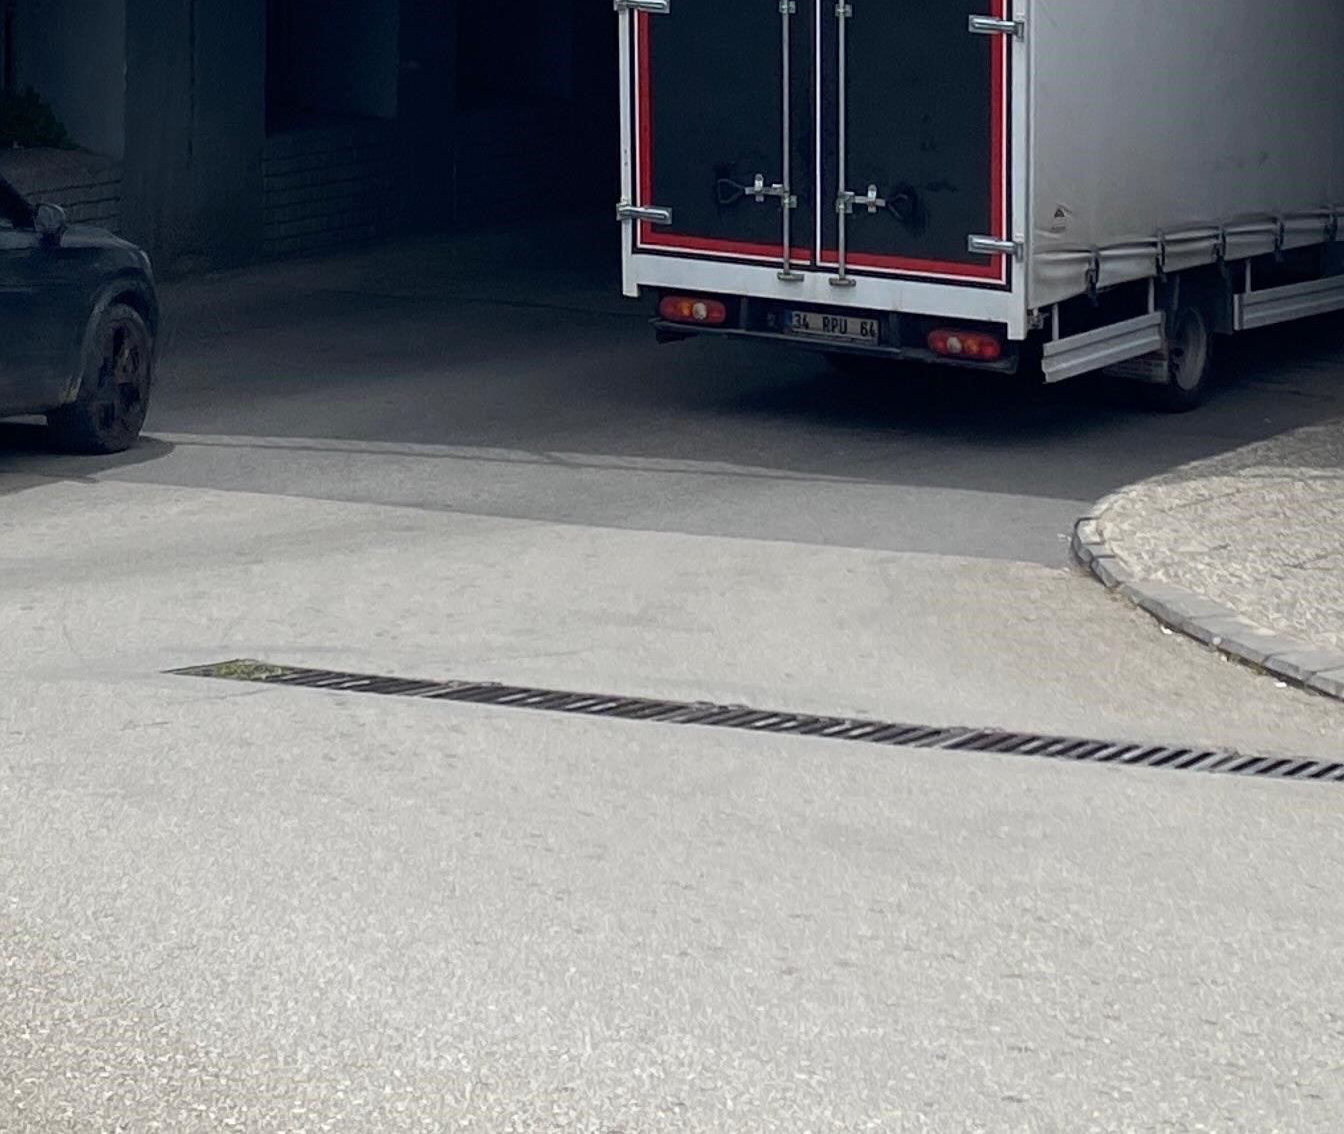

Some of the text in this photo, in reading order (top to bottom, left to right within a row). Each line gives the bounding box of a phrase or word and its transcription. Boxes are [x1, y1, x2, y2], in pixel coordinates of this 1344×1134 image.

[793, 313, 876, 337] 34 RPU 64
